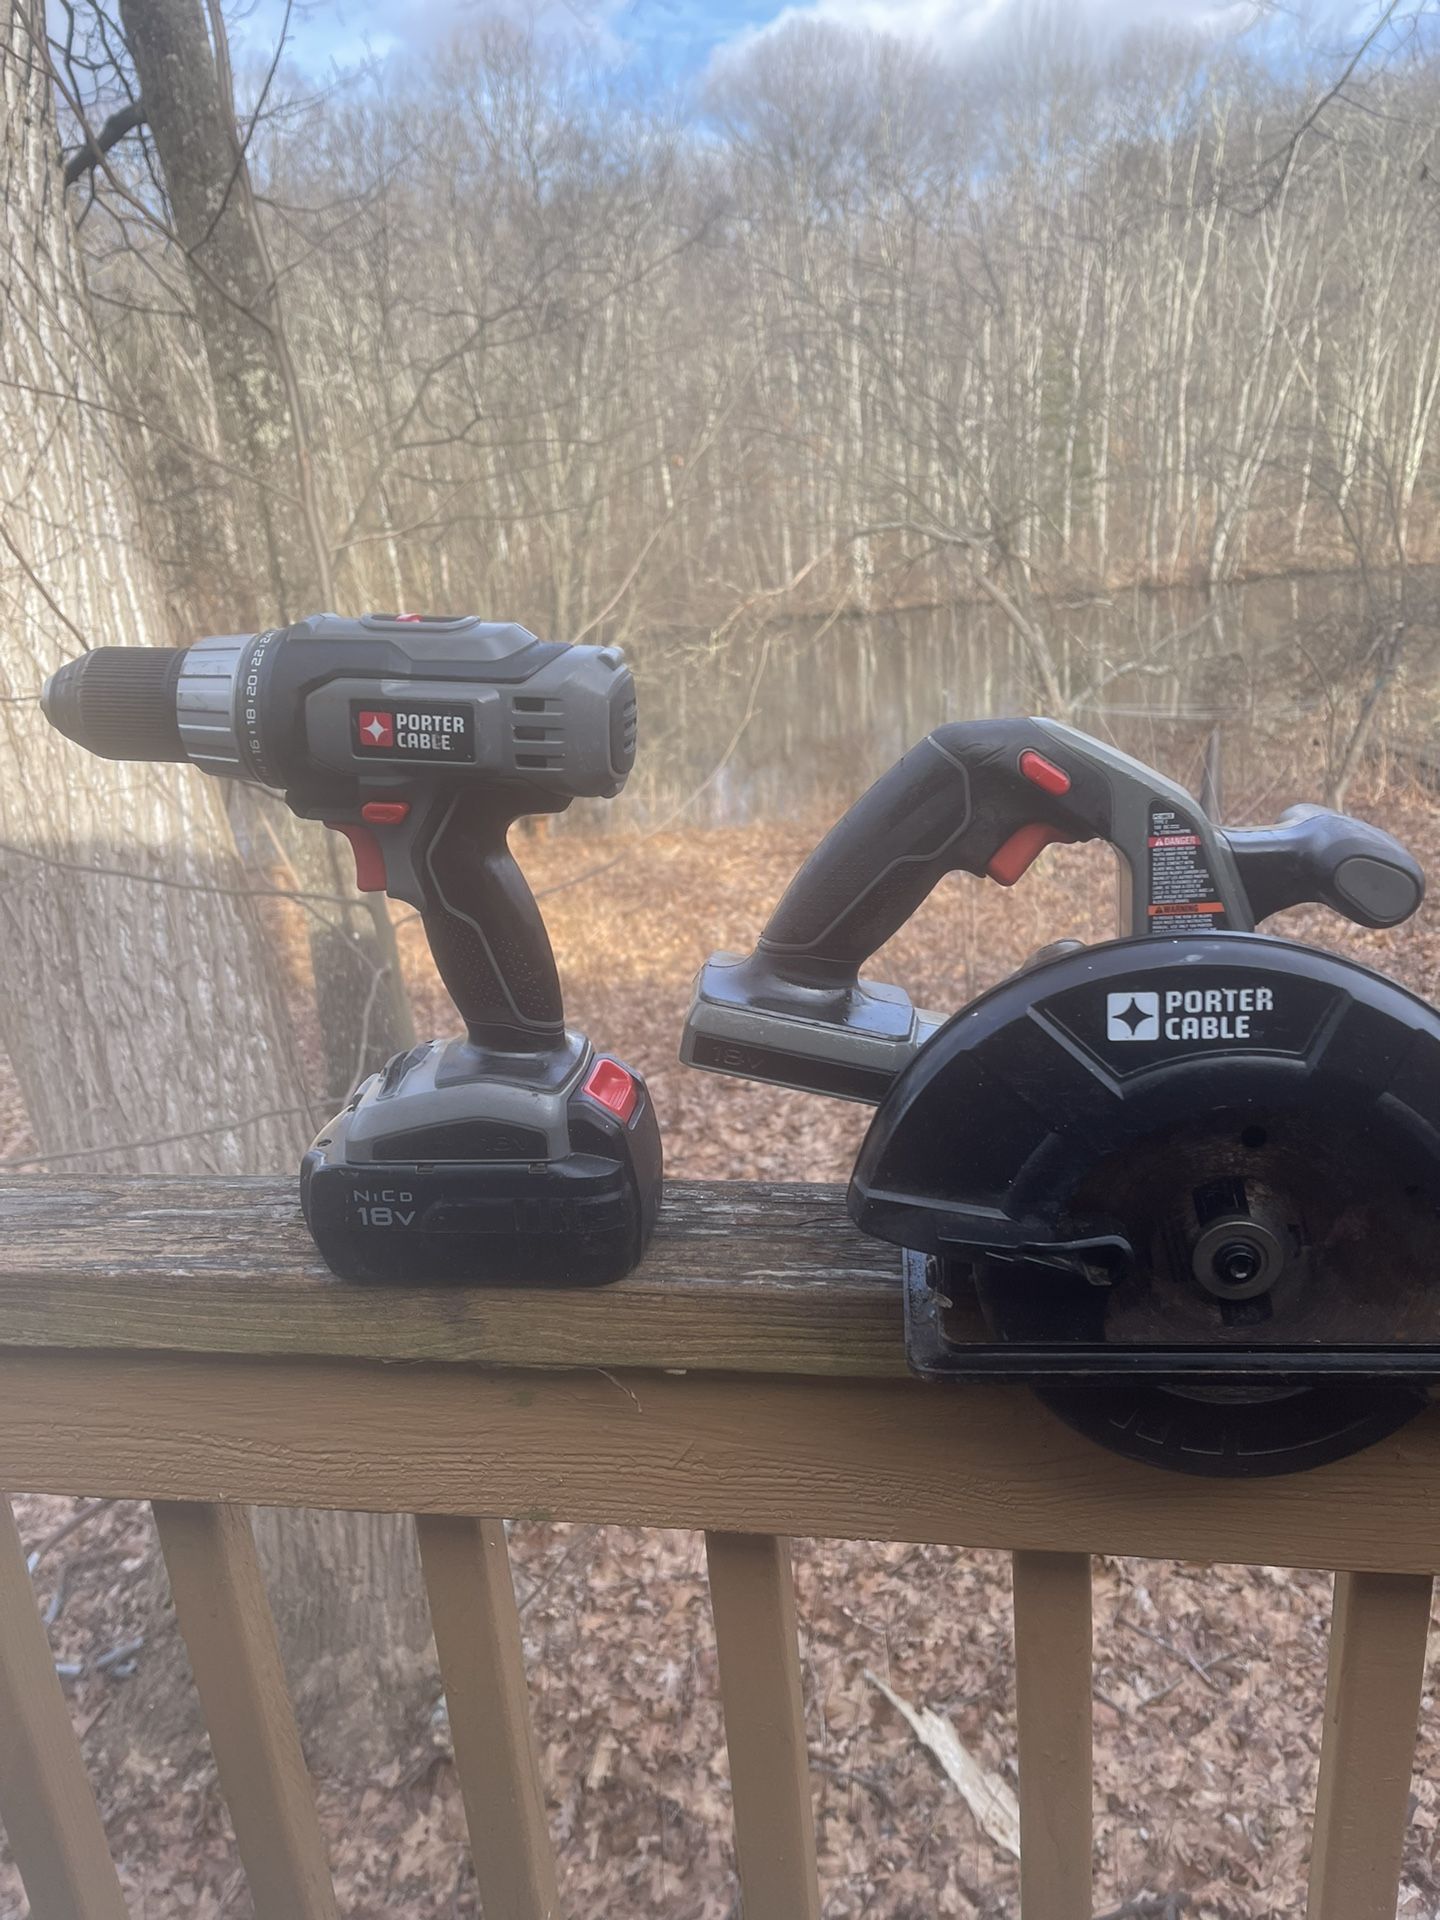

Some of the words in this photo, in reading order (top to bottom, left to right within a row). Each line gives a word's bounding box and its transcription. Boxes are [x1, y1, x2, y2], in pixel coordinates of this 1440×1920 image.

[260, 631, 275, 644] 24
[251, 649, 265, 667] 22
[246, 675, 258, 697] 20
[246, 708, 257, 725] 18
[396, 713, 465, 733] PORTER
[397, 732, 451, 751] CABLE
[1165, 988, 1274, 1014] PORTER
[1165, 1016, 1250, 1041] CABLE
